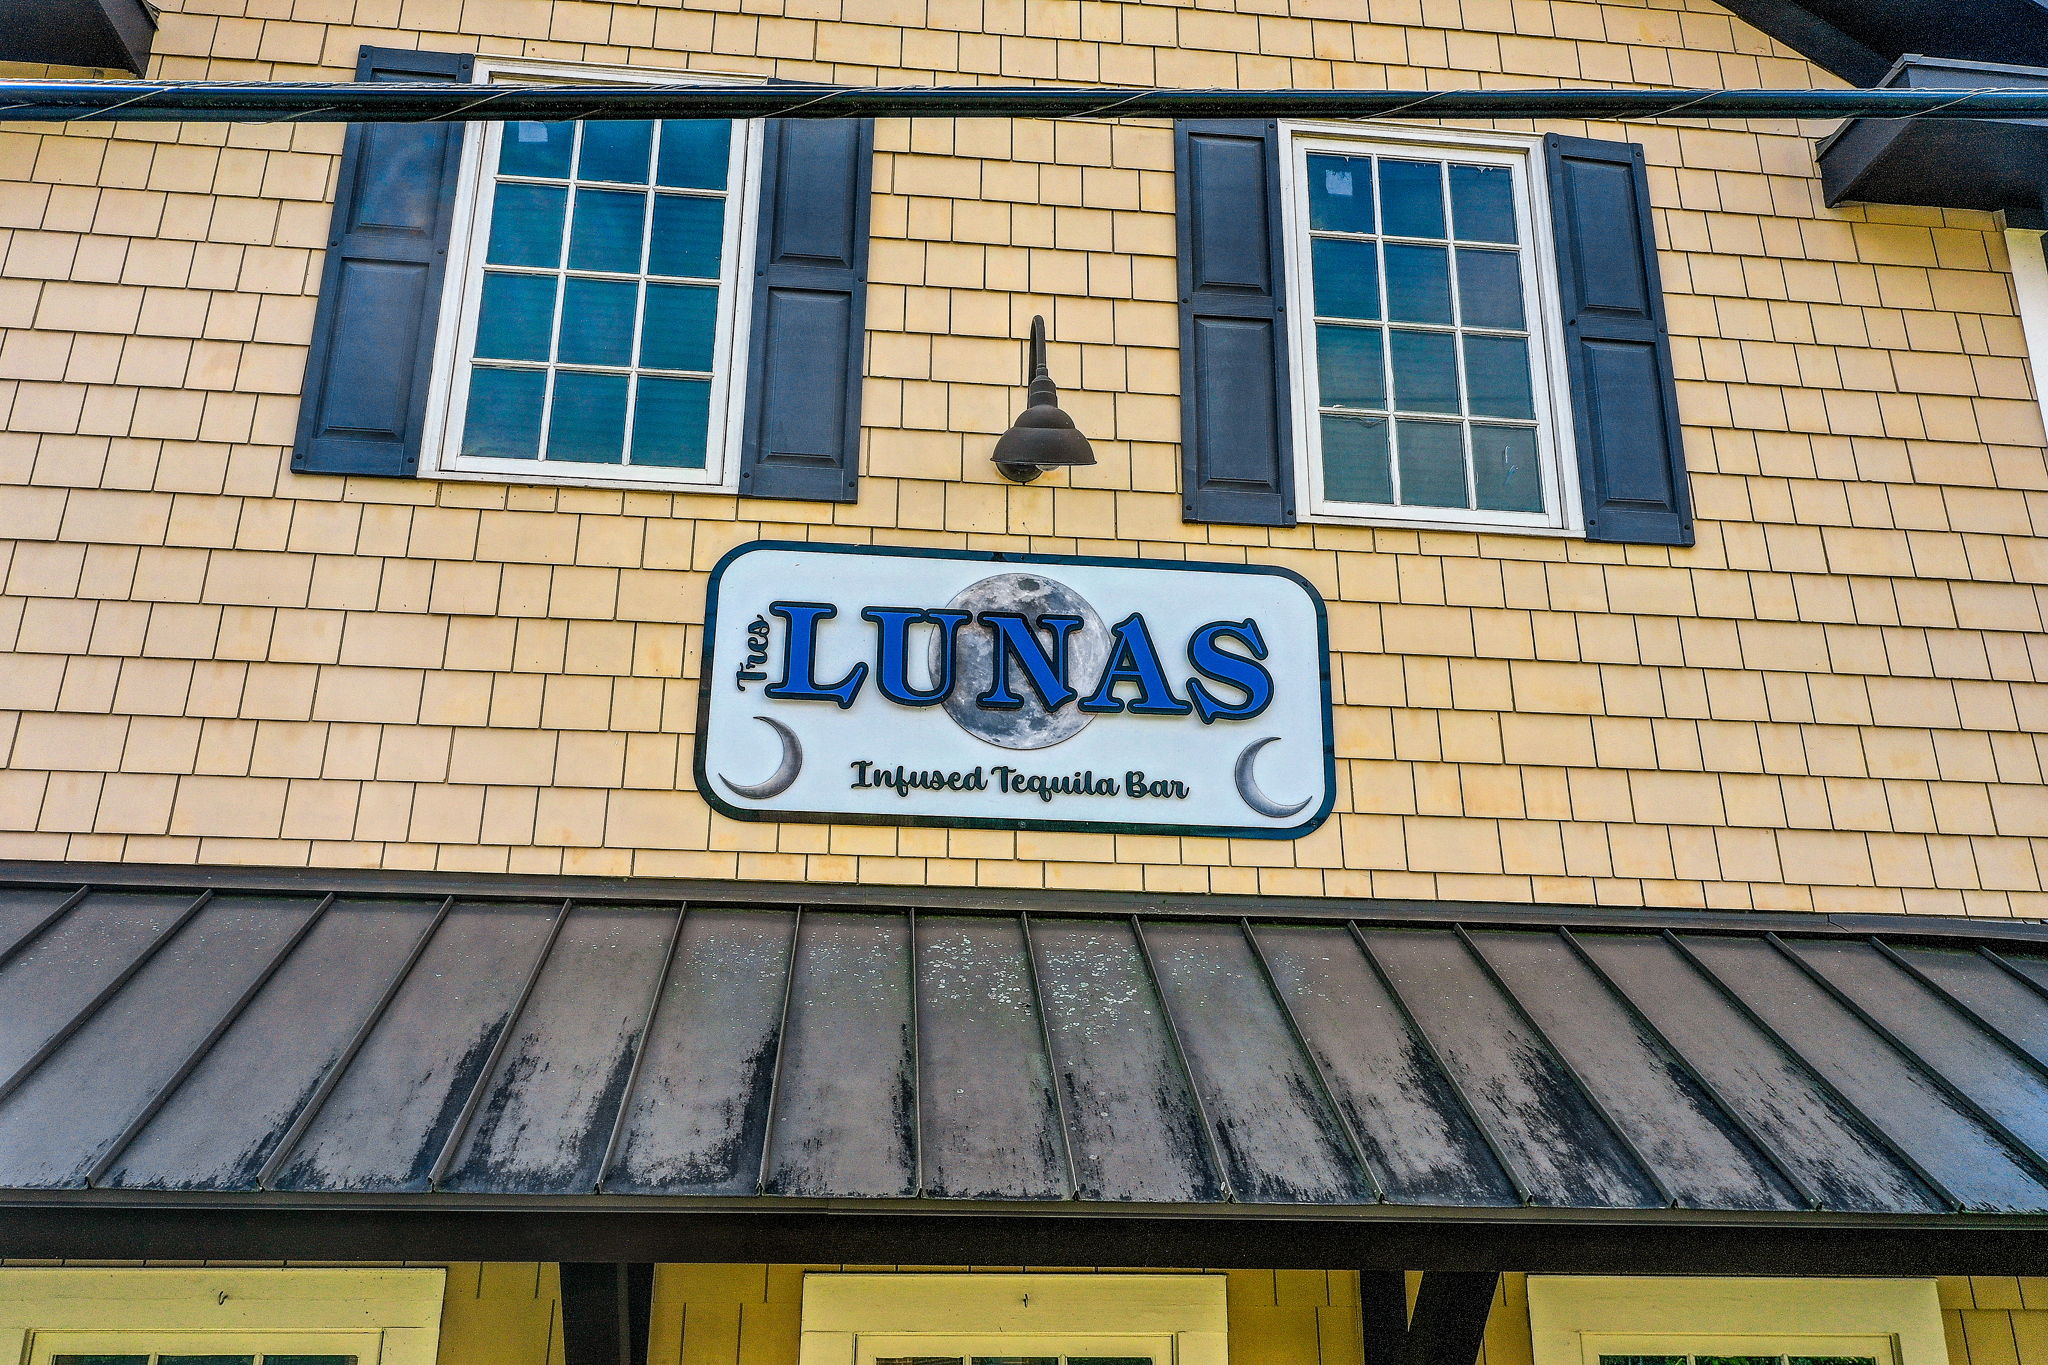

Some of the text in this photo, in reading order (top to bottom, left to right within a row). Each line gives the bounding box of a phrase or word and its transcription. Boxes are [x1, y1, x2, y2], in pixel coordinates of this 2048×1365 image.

[736, 614, 771, 692] Tres
[765, 601, 1275, 725] LUNAS
[850, 760, 1190, 802] Infused Tequila Bar
